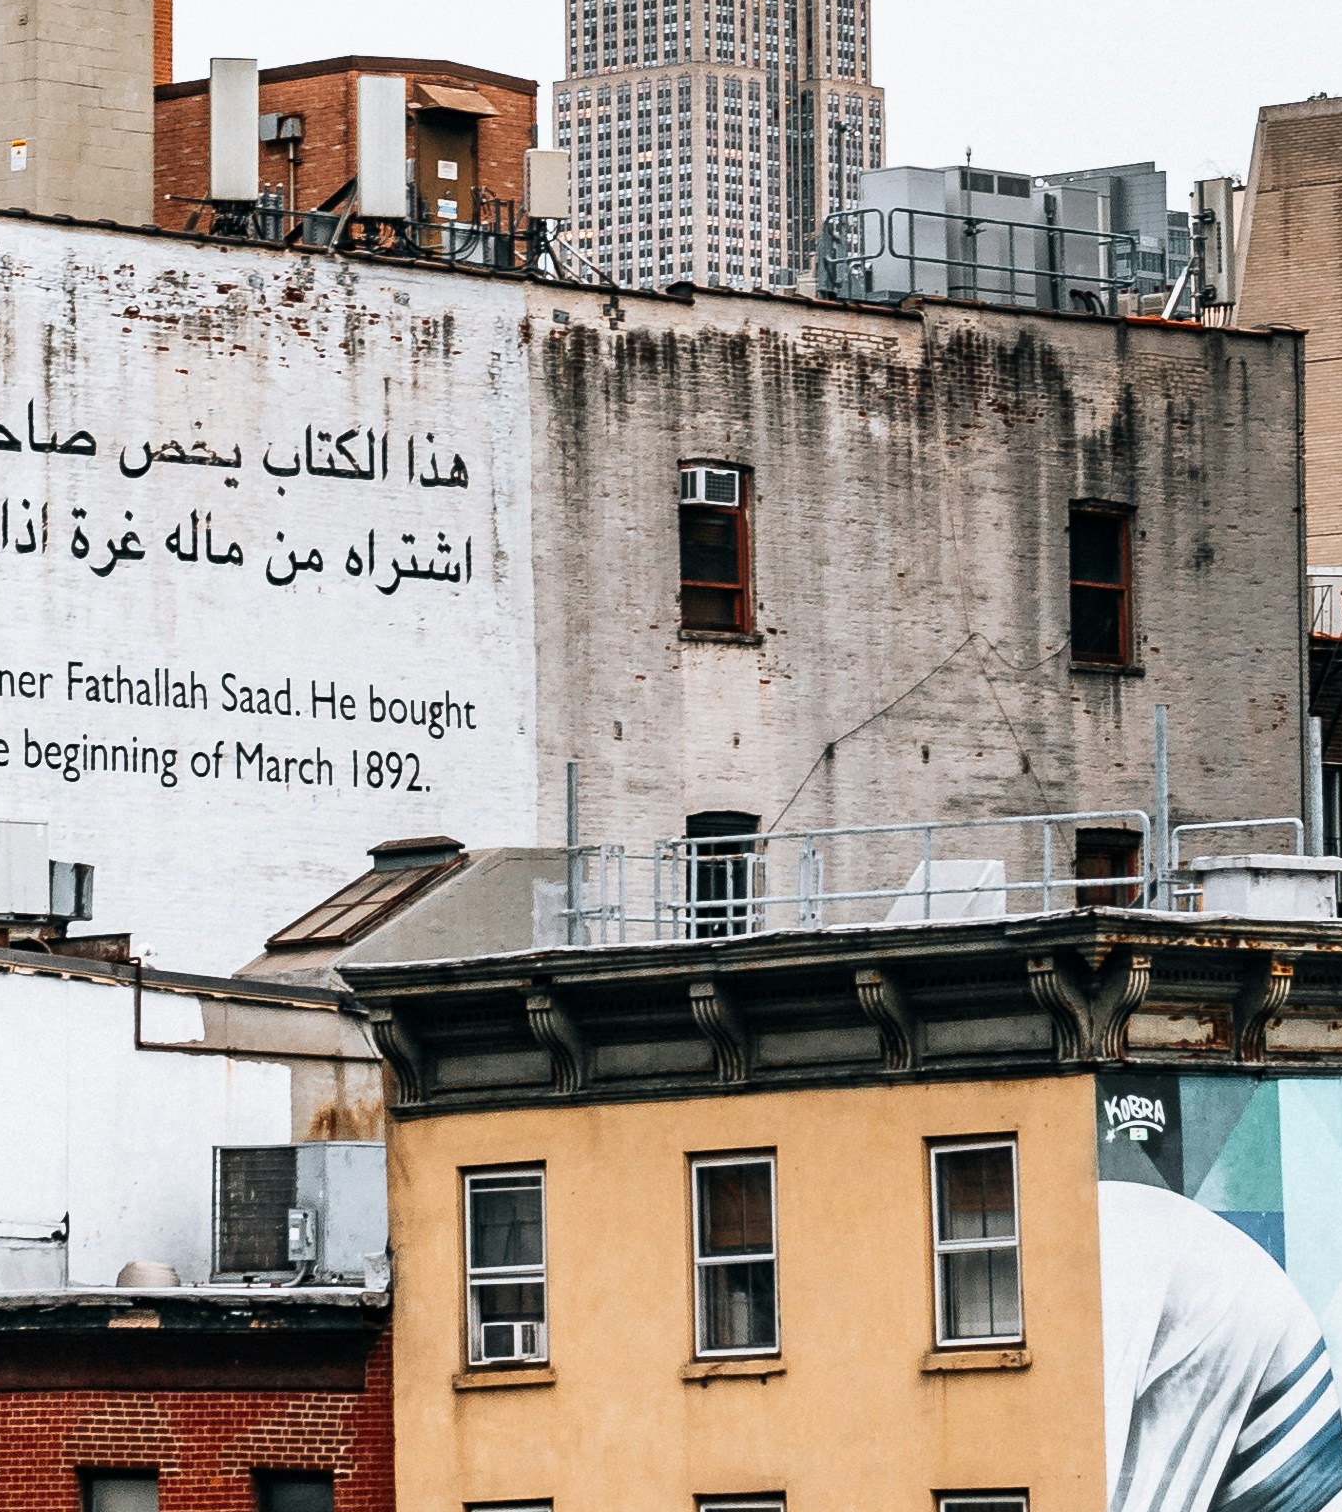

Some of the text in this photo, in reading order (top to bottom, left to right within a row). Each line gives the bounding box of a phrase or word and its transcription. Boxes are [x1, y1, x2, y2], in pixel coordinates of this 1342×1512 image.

[119, 421, 242, 489] يخص
[262, 424, 389, 497] الكتاب
[407, 431, 469, 490] هذا
[70, 507, 147, 577] غرة
[164, 509, 245, 568] ماله
[265, 530, 325, 586] من
[345, 528, 473, 596] اشتراه
[66, 660, 208, 710] Fathallah
[221, 672, 301, 717] Saad.
[311, 679, 356, 721] He
[369, 684, 477, 740] bought
[23, 727, 179, 788] beginning
[190, 740, 225, 779] of
[235, 741, 333, 785] March
[352, 748, 431, 792] 1892.
[1103, 1094, 1166, 1126] KOBRA
